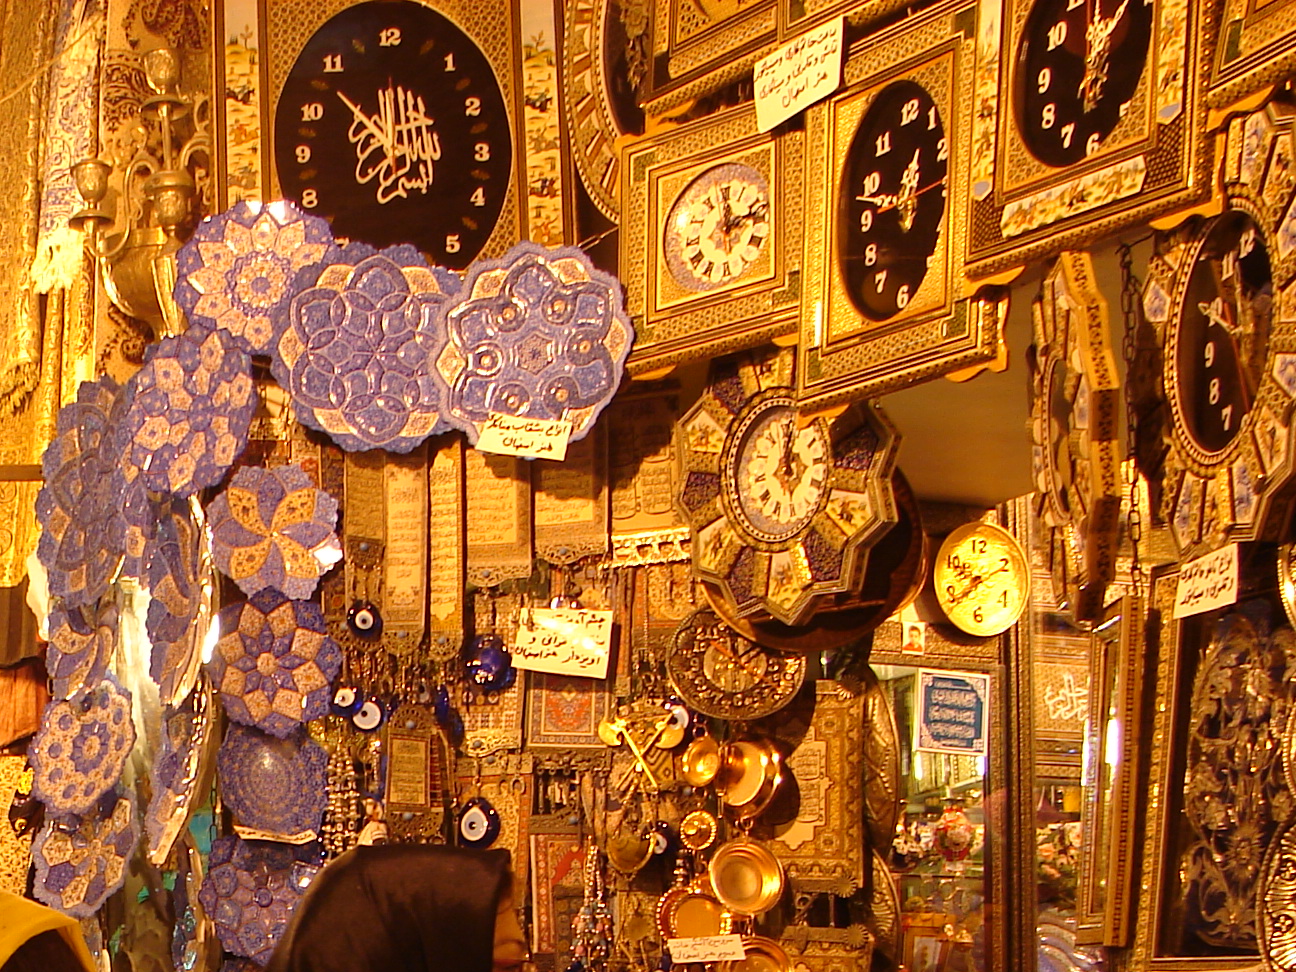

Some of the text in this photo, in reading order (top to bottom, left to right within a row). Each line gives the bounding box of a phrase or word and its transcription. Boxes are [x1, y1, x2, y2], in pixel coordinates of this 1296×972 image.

[379, 28, 402, 47] 12
[1047, 21, 1068, 51] 10
[323, 55, 344, 73] 11
[444, 53, 456, 72] 1
[1038, 67, 1051, 94] 9
[301, 103, 324, 121] 10
[465, 97, 481, 117] 2
[901, 99, 919, 127] 12
[927, 106, 936, 130] 1
[1041, 103, 1055, 129] 8
[875, 131, 891, 157] 11
[1061, 123, 1075, 149] 7
[295, 146, 311, 163] 9
[474, 144, 490, 162] 3
[863, 172, 880, 197] 10
[302, 189, 318, 208] 8
[470, 187, 485, 206] 4
[861, 209, 873, 232] 9
[446, 235, 460, 253] 5
[865, 243, 877, 266] 8
[1238, 229, 1255, 259] 12
[1221, 251, 1234, 281] 11
[875, 270, 887, 293] 7
[897, 285, 909, 309] 6
[1204, 341, 1215, 368] 9
[1209, 377, 1220, 405] 8
[1221, 404, 1233, 431] 7
[972, 539, 987, 553] 12
[999, 557, 1009, 572] 2
[973, 606, 983, 623] 6
